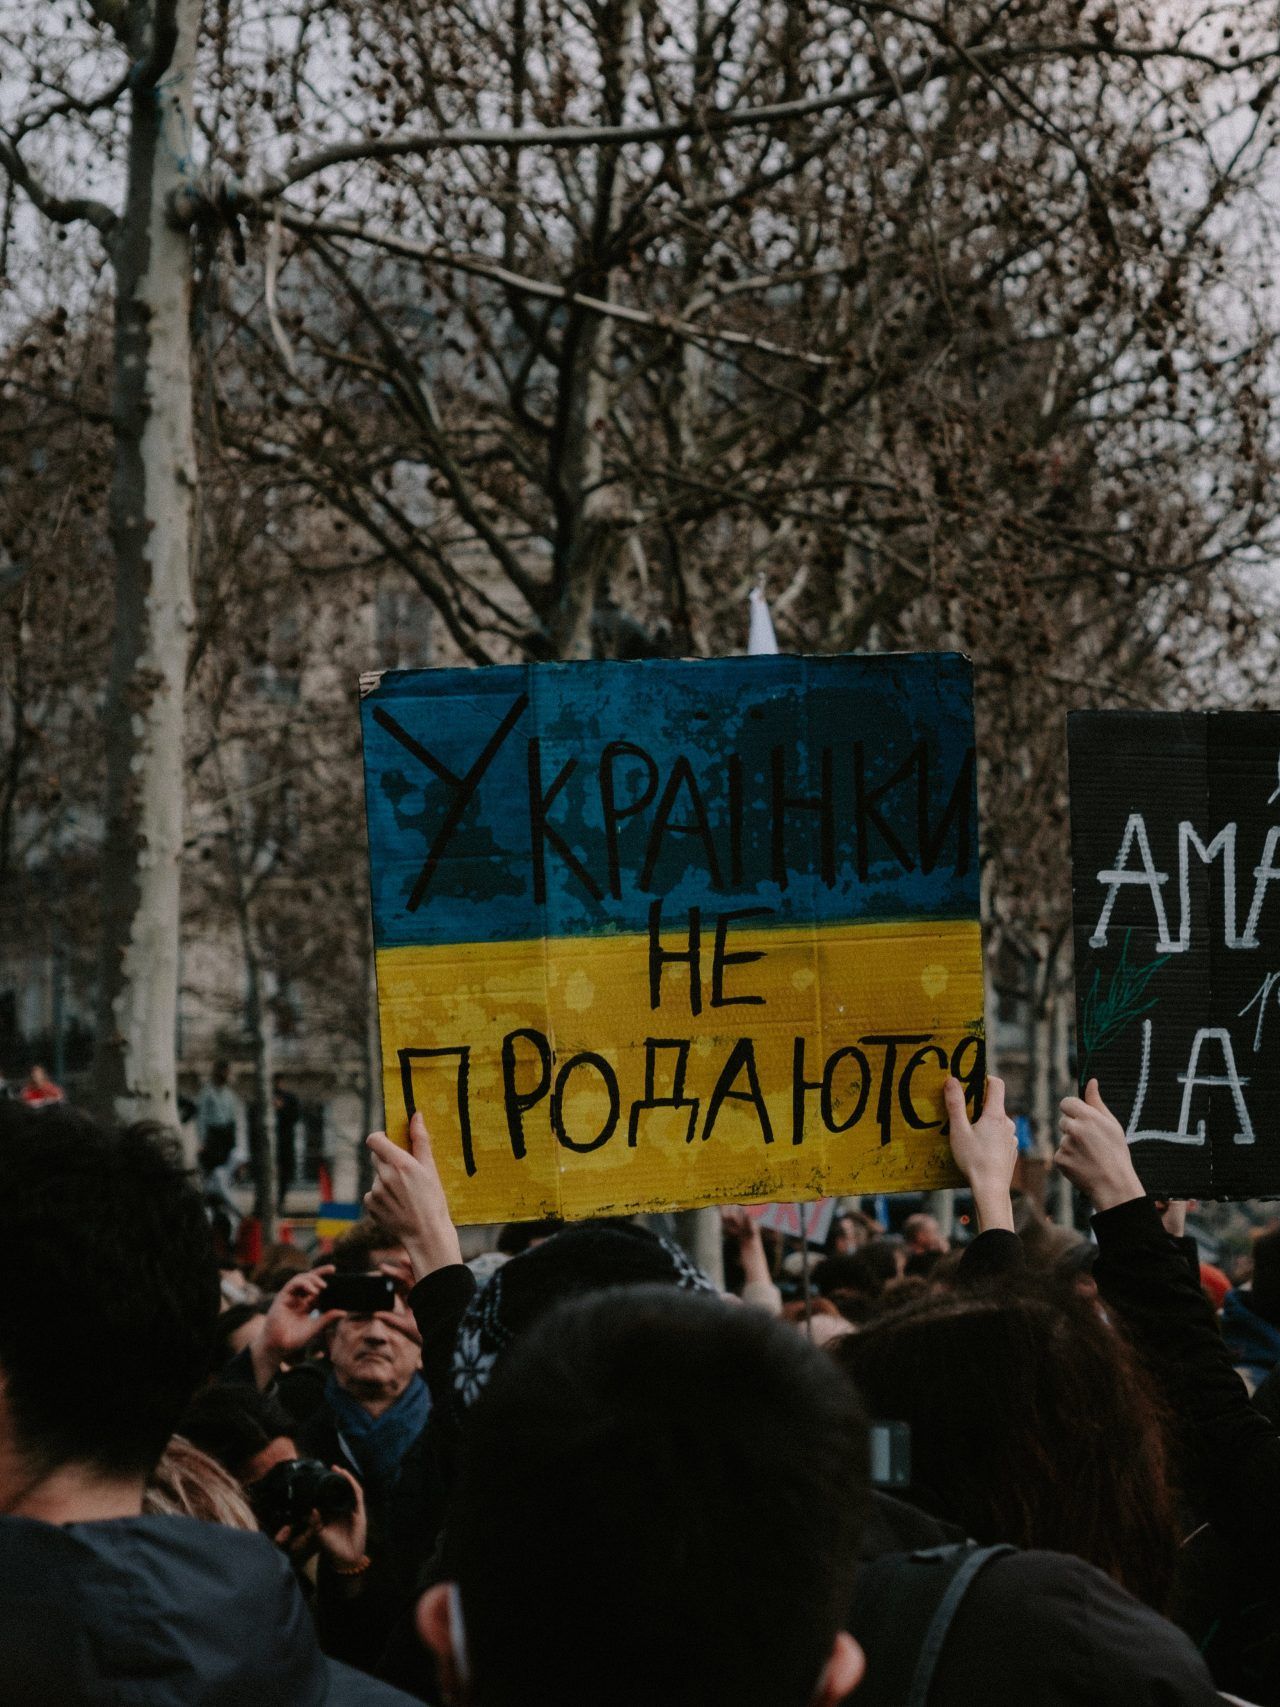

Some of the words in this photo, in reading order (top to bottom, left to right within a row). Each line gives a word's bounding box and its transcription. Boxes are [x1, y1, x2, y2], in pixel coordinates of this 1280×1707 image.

[648, 901, 776, 1017] НЕ
[396, 1027, 987, 1178] ПРОДАЮТСЯ
[1126, 1020, 1255, 1146] LA
